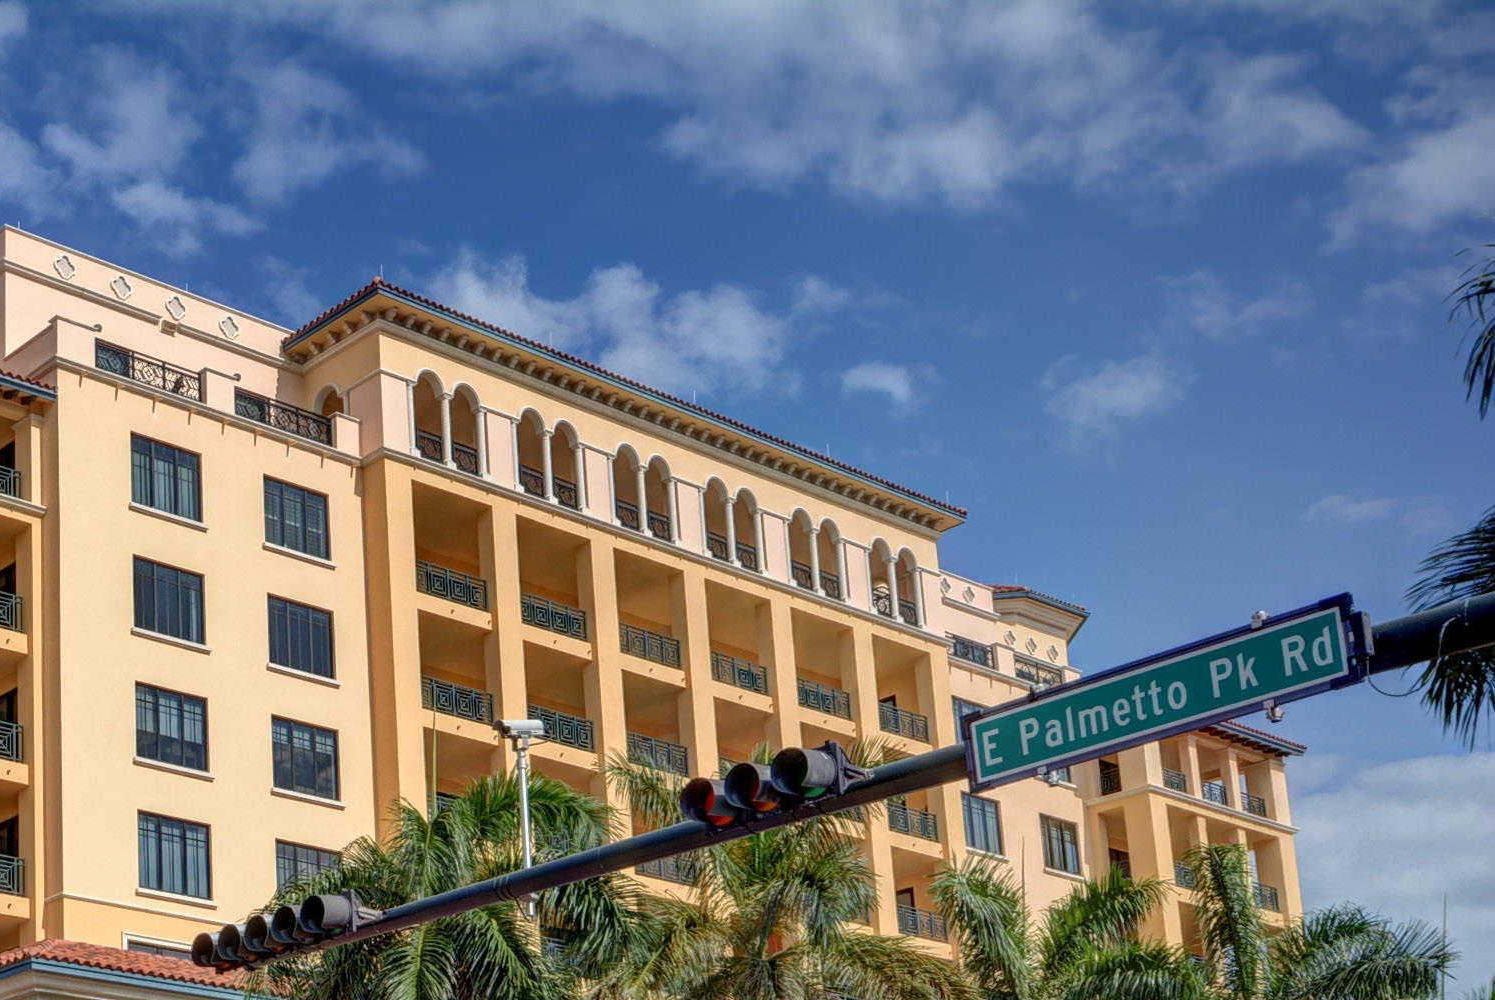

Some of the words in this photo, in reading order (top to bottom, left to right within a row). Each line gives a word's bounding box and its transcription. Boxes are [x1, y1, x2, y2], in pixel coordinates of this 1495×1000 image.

[982, 728, 1003, 767] E
[1019, 679, 1187, 756] Palmetto
[1209, 652, 1259, 698] Pk
[1280, 625, 1334, 677] Rd
